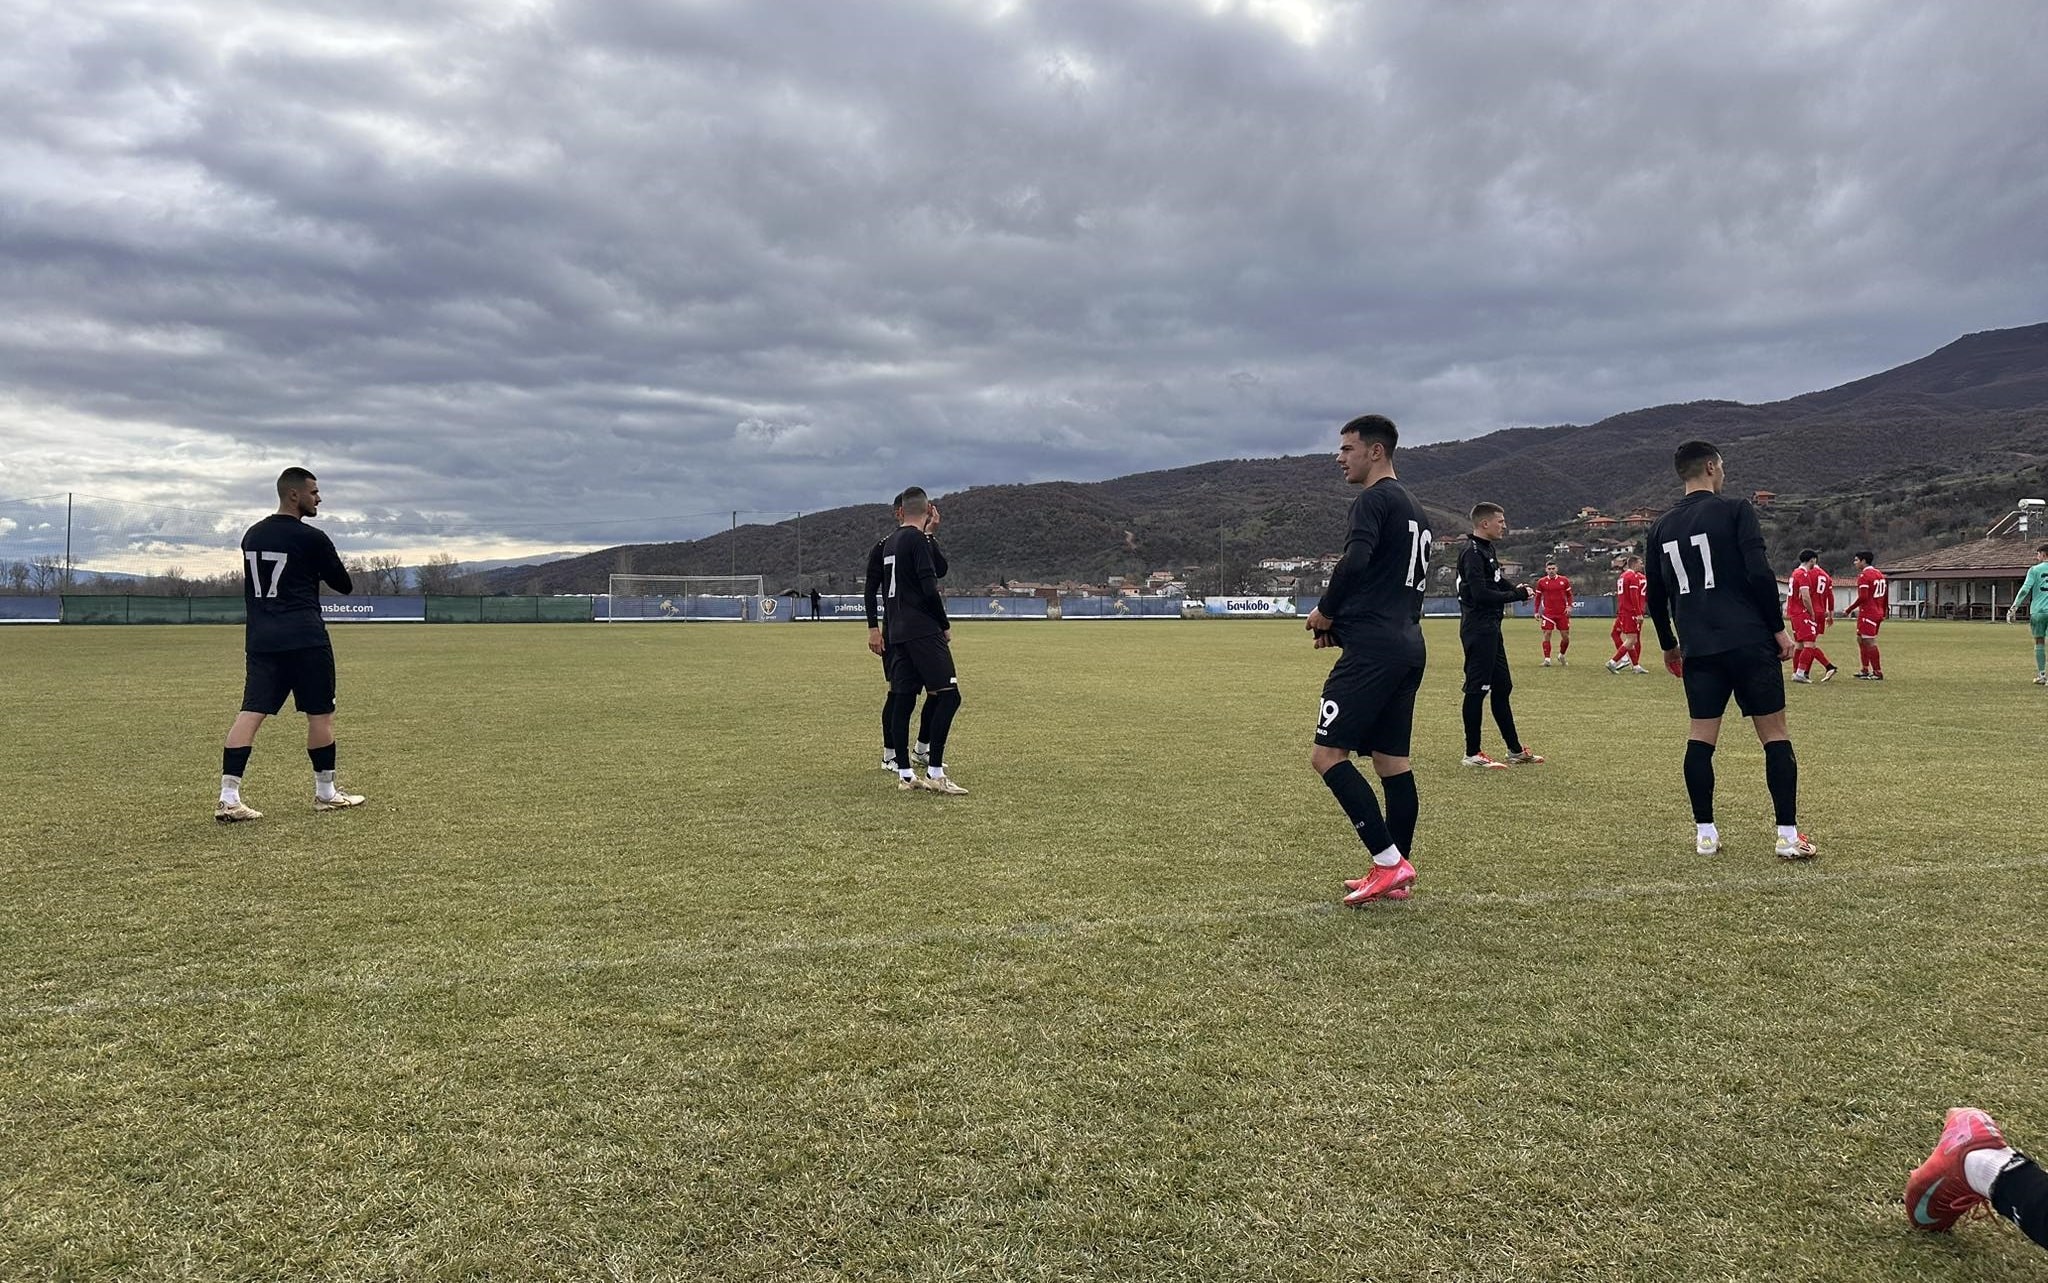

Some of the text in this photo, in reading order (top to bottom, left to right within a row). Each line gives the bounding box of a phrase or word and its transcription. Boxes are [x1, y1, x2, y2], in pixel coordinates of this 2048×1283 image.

[1405, 519, 1432, 592] 19
[1662, 533, 1715, 595] 11
[245, 551, 288, 598] 17
[1816, 576, 1827, 594] 6
[1873, 579, 1886, 598] 20
[320, 604, 374, 612] msbet.com
[1227, 600, 1270, 611] Бачково
[1317, 697, 1339, 728] 19
